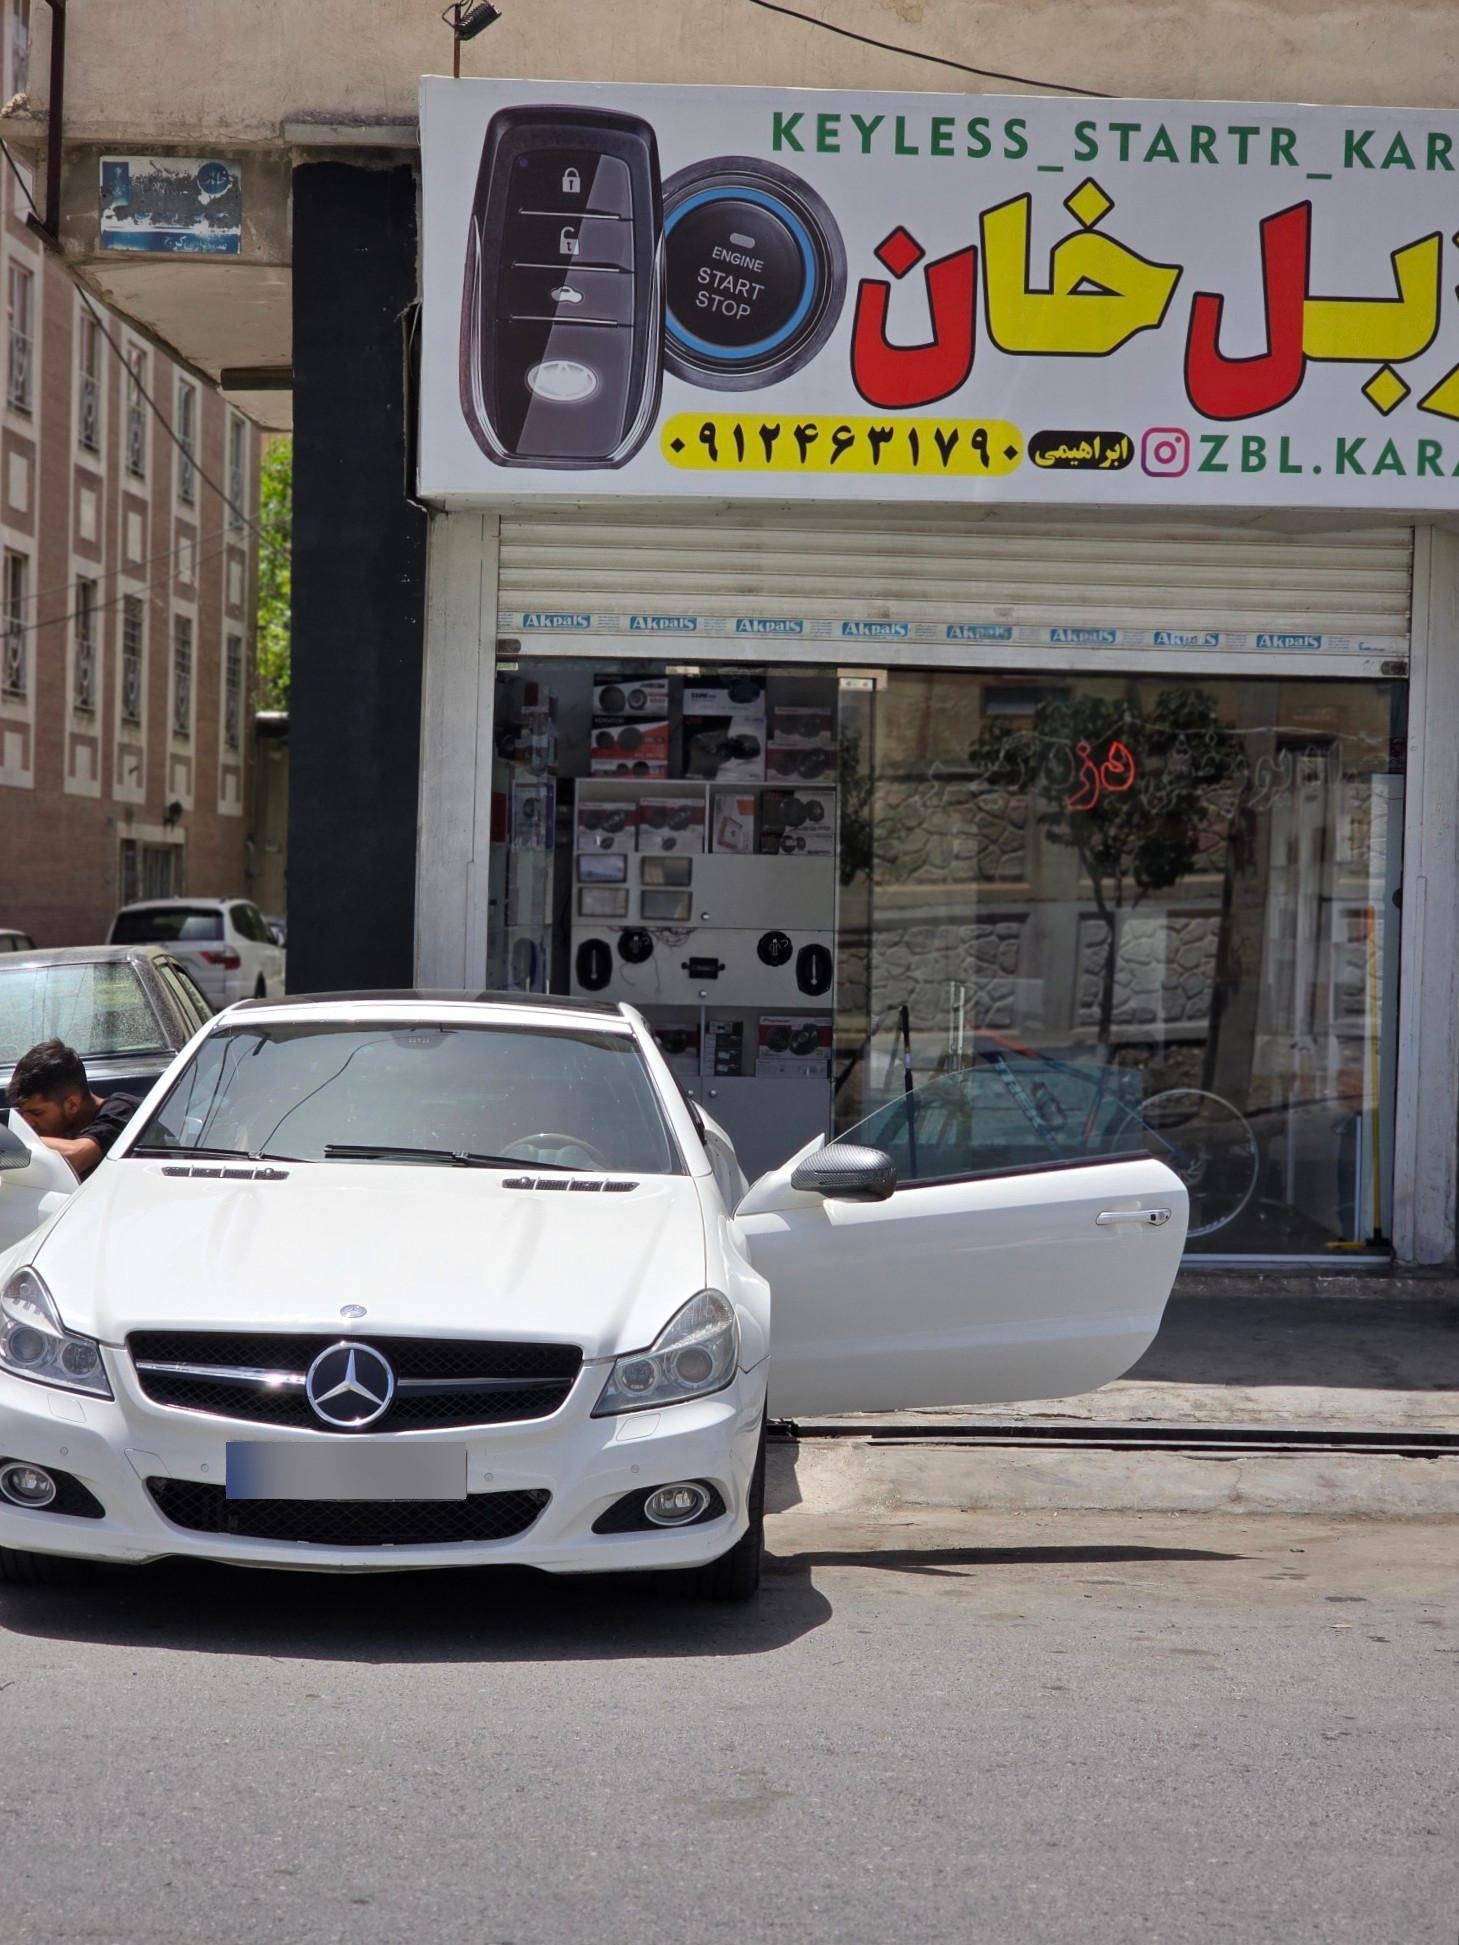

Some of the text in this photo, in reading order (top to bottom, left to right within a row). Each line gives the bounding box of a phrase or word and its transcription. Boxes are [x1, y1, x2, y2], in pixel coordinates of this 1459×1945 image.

[711, 246, 766, 273] ENGINE
[696, 266, 766, 302] START
[851, 177, 1183, 409] خان
[694, 290, 752, 321] STOP
[1034, 437, 1128, 468] ابراهیمی
